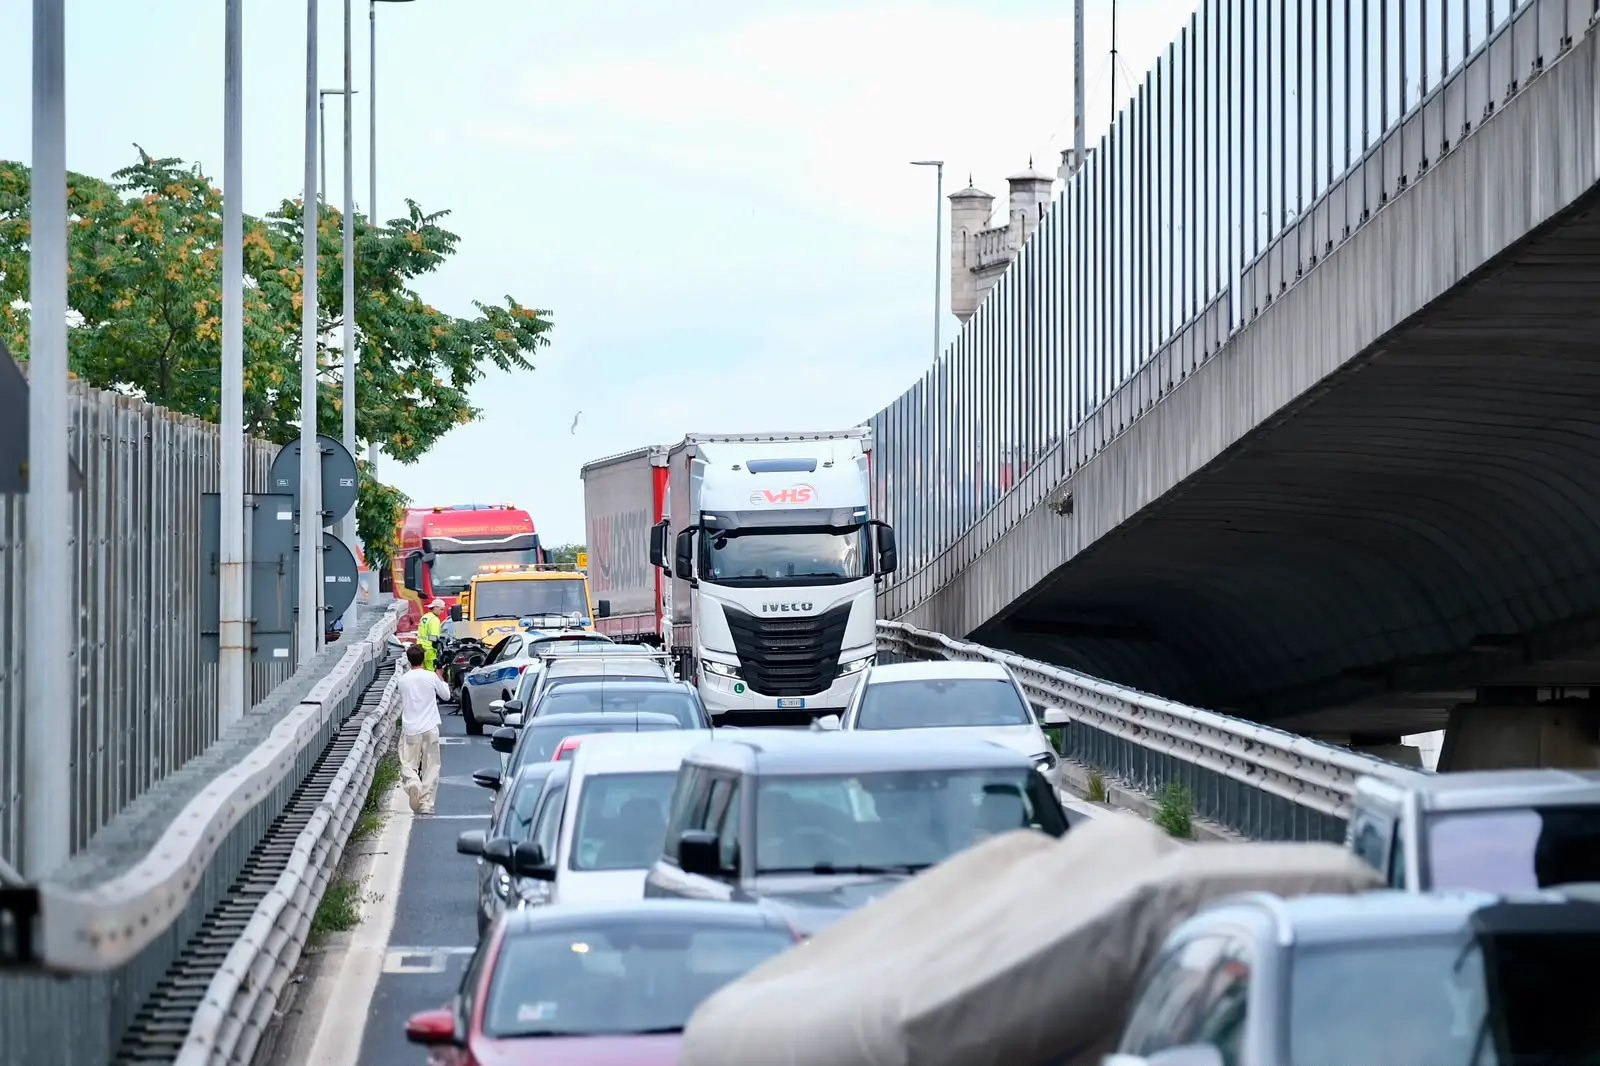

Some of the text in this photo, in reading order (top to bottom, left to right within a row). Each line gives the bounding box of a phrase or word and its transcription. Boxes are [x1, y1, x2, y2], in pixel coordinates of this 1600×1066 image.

[763, 488, 812, 503] VHS
[762, 602, 813, 612] IVECO
[736, 684, 742, 692] L
